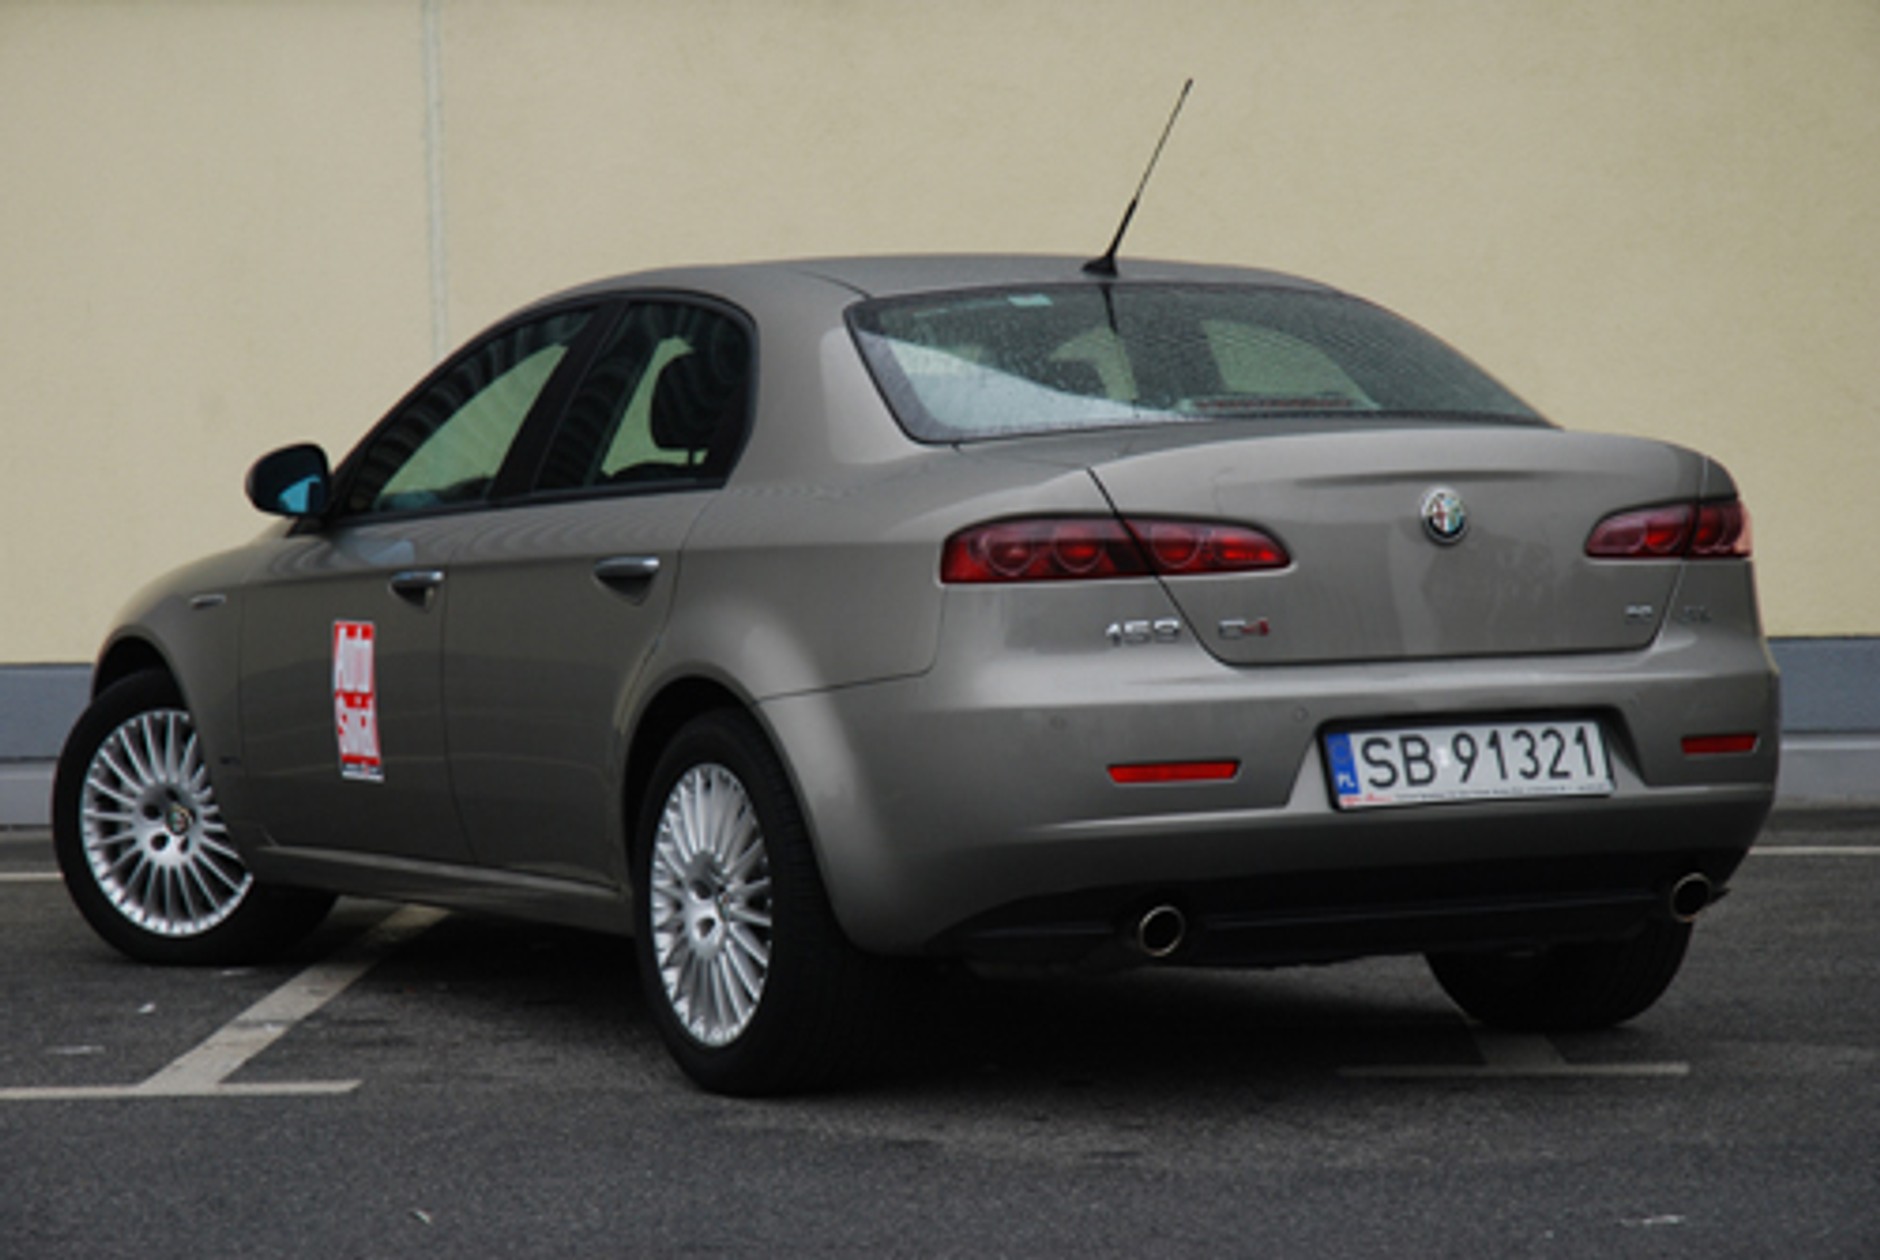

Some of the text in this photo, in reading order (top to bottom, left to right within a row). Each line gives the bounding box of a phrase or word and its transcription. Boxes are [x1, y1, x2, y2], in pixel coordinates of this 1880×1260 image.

[1106, 619, 1180, 646] 159
[1361, 726, 1595, 789] SB 91321
